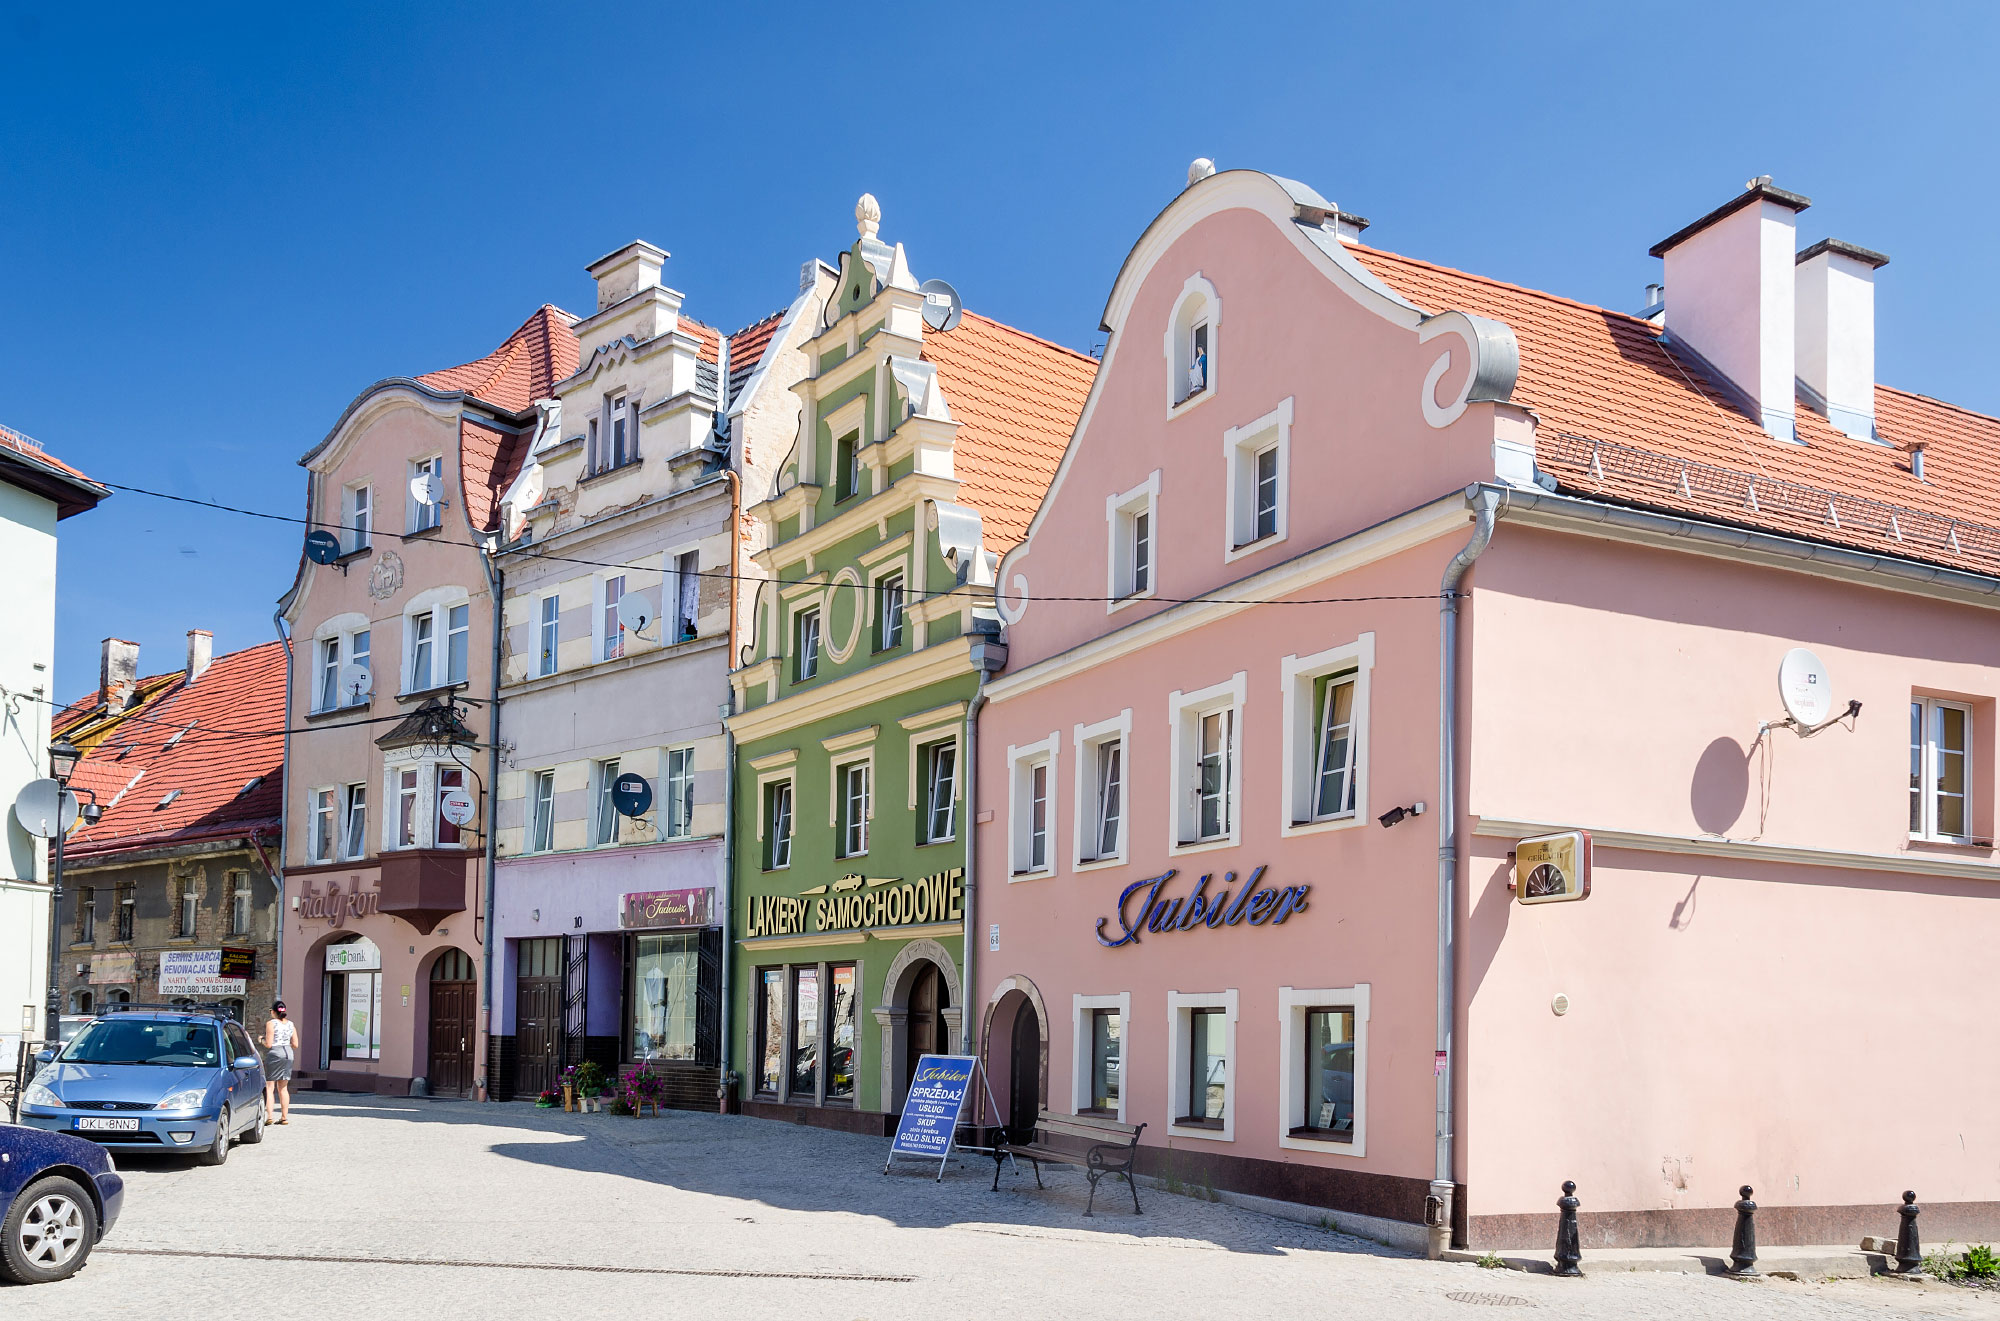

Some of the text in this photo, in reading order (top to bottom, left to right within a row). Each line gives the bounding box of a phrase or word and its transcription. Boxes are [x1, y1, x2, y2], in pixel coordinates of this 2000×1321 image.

[646, 897, 687, 919] Tadeusz
[746, 867, 963, 937] LAKIERY SAMOCHODOWE
[1096, 865, 1311, 947] Jubiler
[573, 915, 583, 929] 10
[168, 952, 193, 963] SERWIS
[193, 951, 221, 962] NARCIA
[164, 964, 206, 974] RENOWACJA
[233, 985, 242, 993] 40
[916, 1067, 968, 1082] Jubiler
[912, 1087, 963, 1101] SPRZEDAŻ
[918, 1104, 945, 1114] USŁUGI
[81, 1118, 137, 1130] DKL 8NN3
[917, 1118, 936, 1127] SKUP
[900, 1132, 947, 1145] GOLD SILVER
